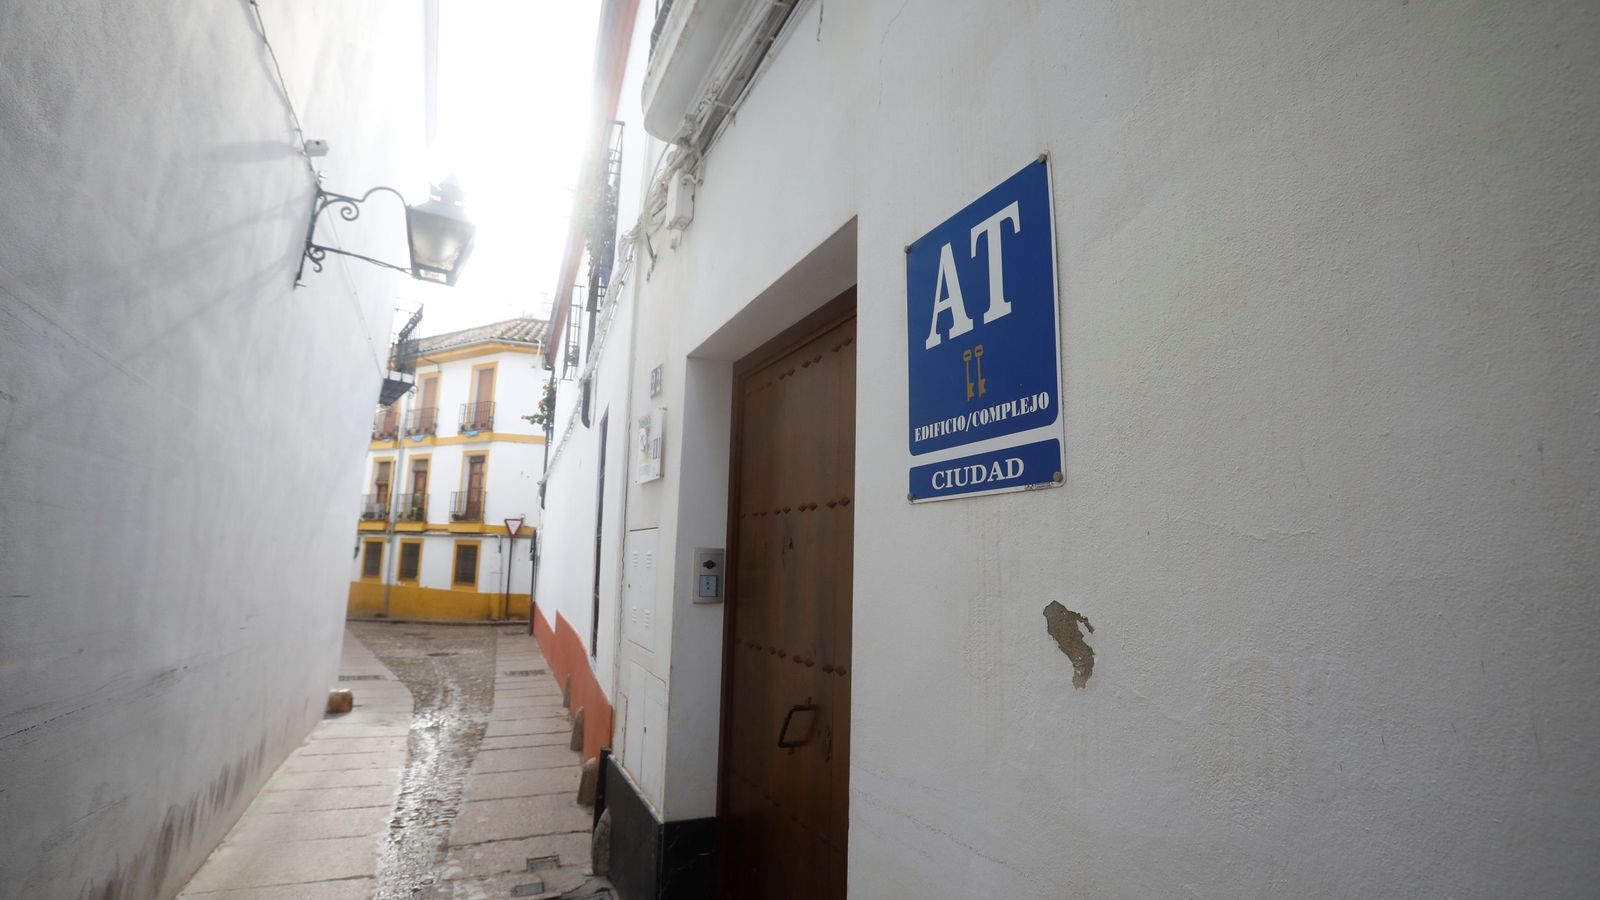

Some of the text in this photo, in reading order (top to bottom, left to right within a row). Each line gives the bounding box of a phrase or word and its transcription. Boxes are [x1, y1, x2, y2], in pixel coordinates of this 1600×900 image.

[925, 200, 1021, 350] AT
[914, 391, 1050, 442] EDIFICIO/COMPLEJO
[931, 457, 1025, 490] CIUDAD
